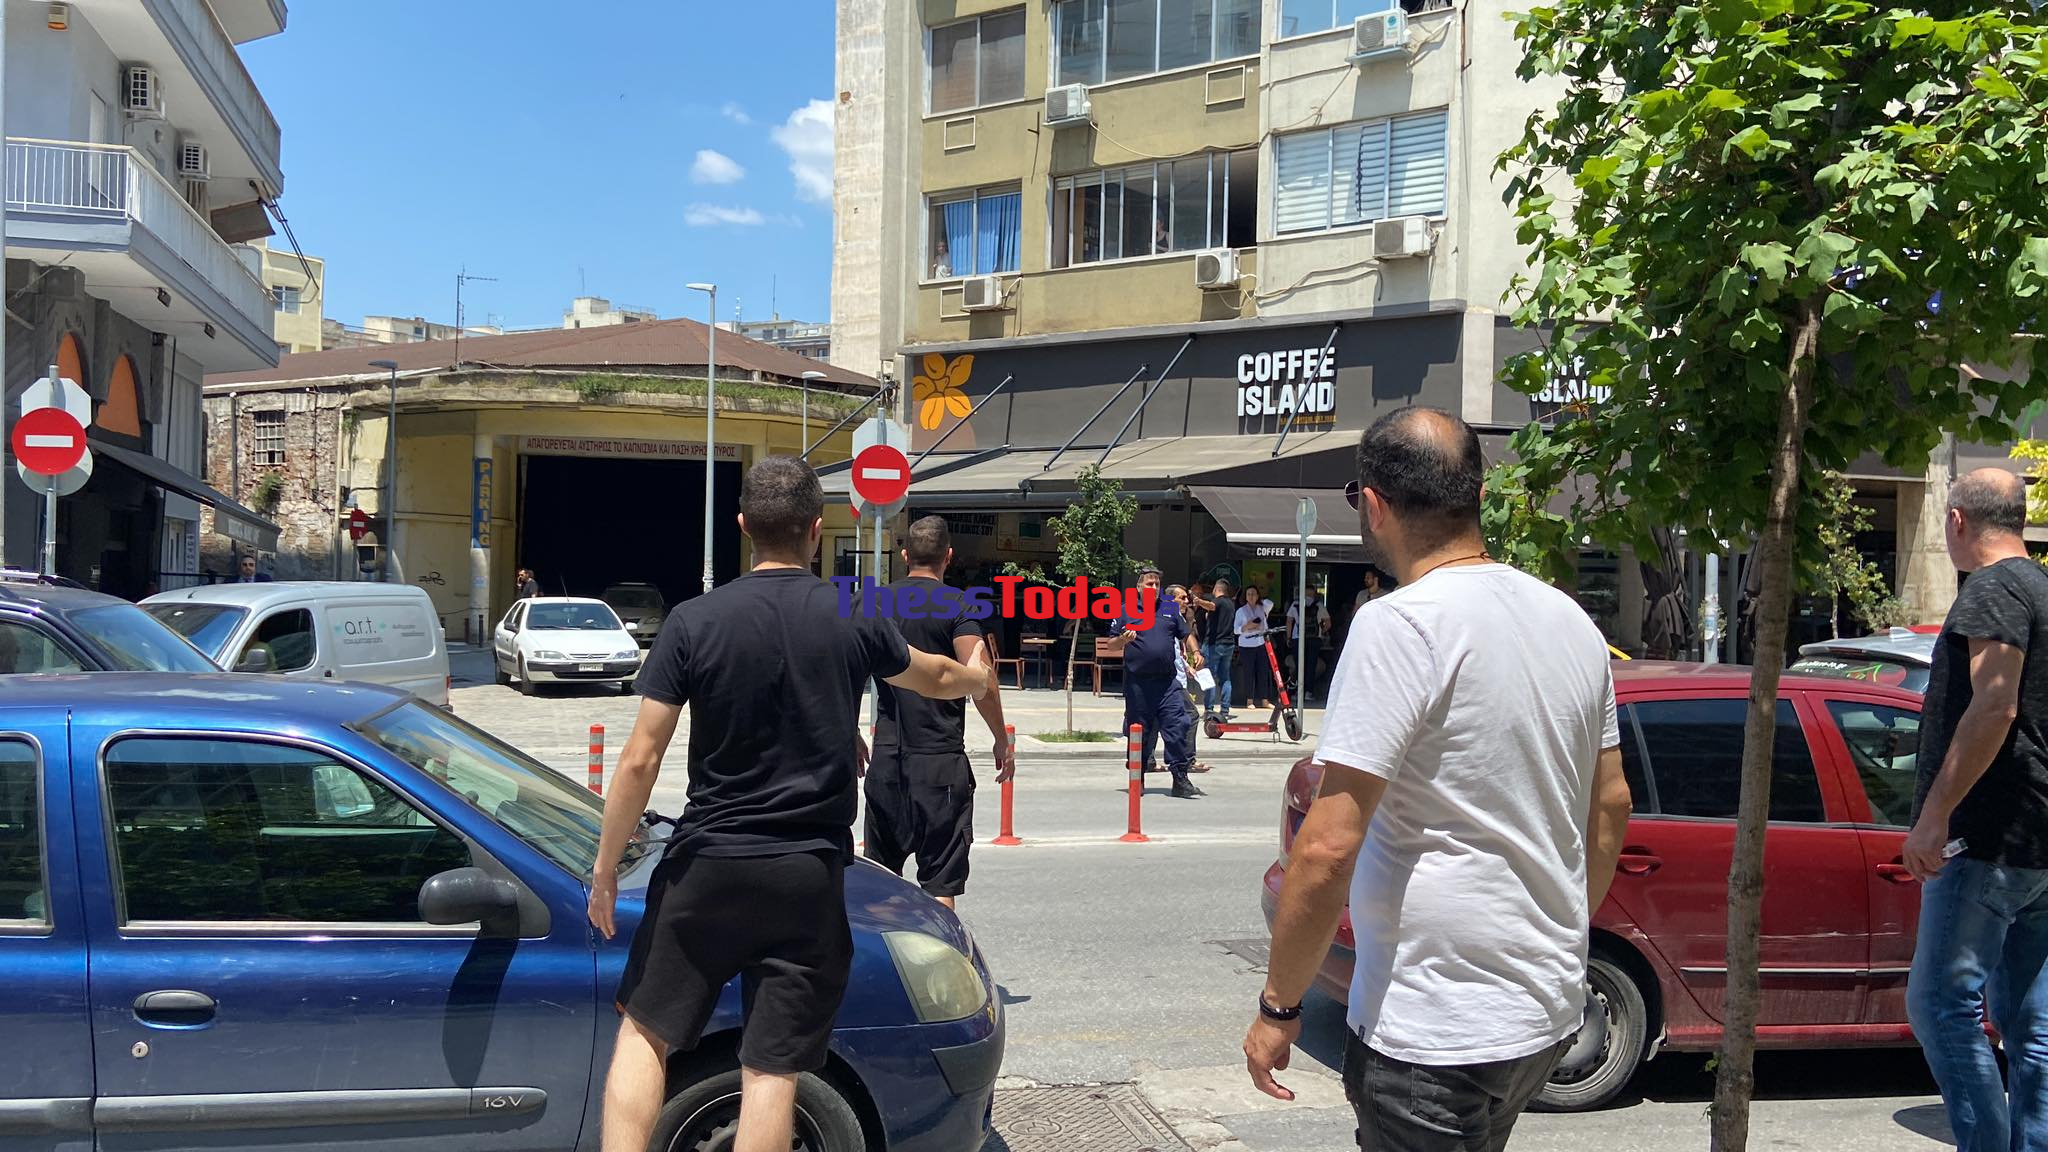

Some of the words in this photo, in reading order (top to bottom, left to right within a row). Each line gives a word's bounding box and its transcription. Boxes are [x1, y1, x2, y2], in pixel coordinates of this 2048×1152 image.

[1237, 346, 1336, 384] COFFEE
[1237, 381, 1336, 417] ISLAND
[527, 438, 577, 451] ΑΠΑΓΟΡΕΥΕΤΑΙ
[578, 440, 613, 452] ΑΥΣΤΗΡΩΣ
[613, 441, 622, 453] ΤΟ
[623, 442, 658, 454] ΚΑΠΝΙΣΜΑ
[659, 443, 670, 455] ΚΑΙ
[671, 444, 689, 455] ΠΑΣΗ
[691, 444, 708, 456] ΧΡΗΣ
[479, 461, 491, 546] PARKING
[1256, 547, 1285, 556] COFFEE
[1288, 547, 1318, 557] ISLND
[344, 616, 377, 636] a.r.t.
